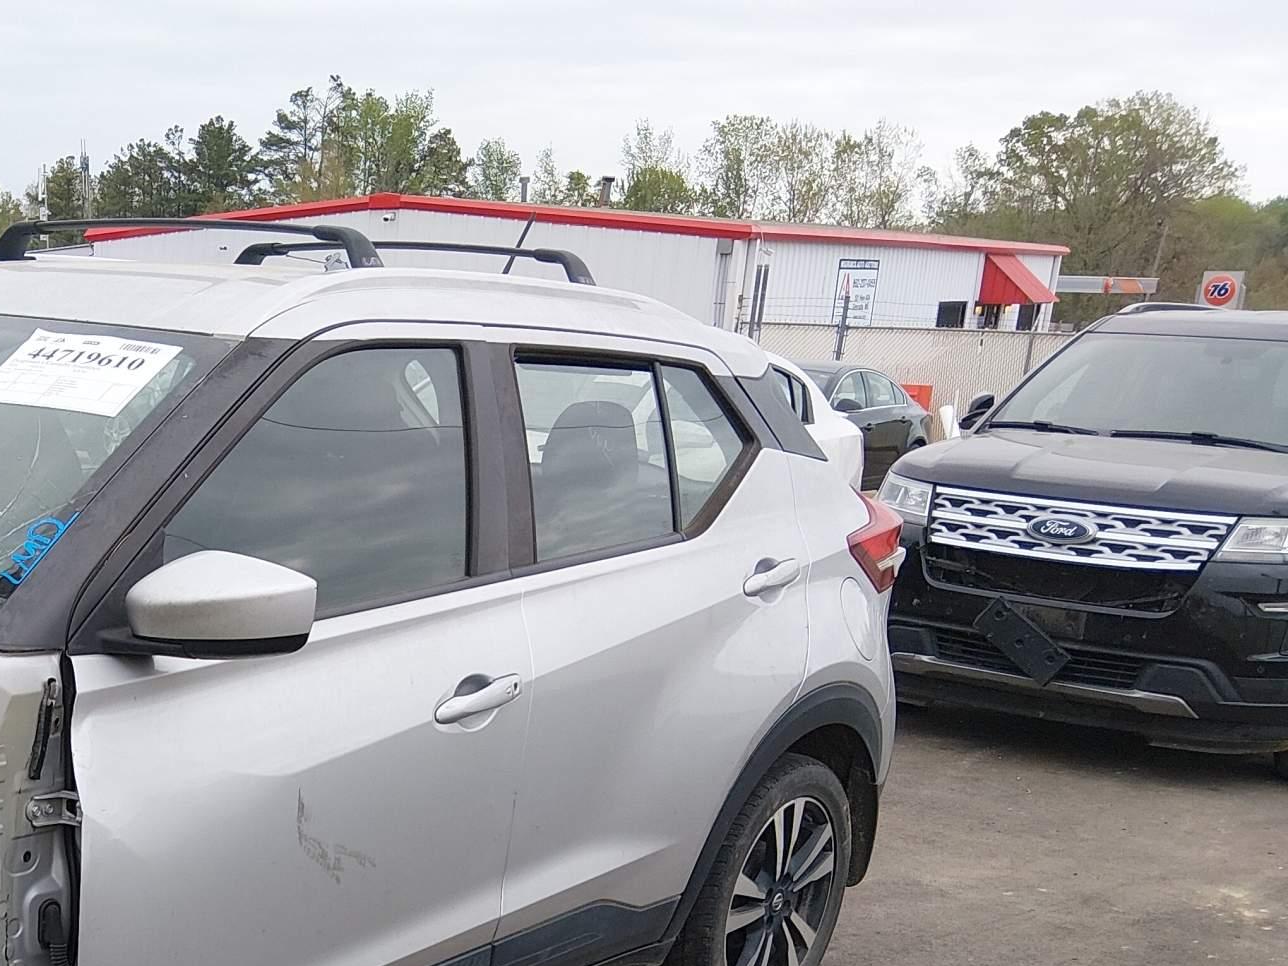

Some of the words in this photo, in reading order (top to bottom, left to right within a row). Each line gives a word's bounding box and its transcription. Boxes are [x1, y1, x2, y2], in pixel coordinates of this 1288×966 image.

[1208, 282, 1231, 297] 76
[27, 346, 145, 371] 44719610
[1040, 519, 1078, 537] Ford
